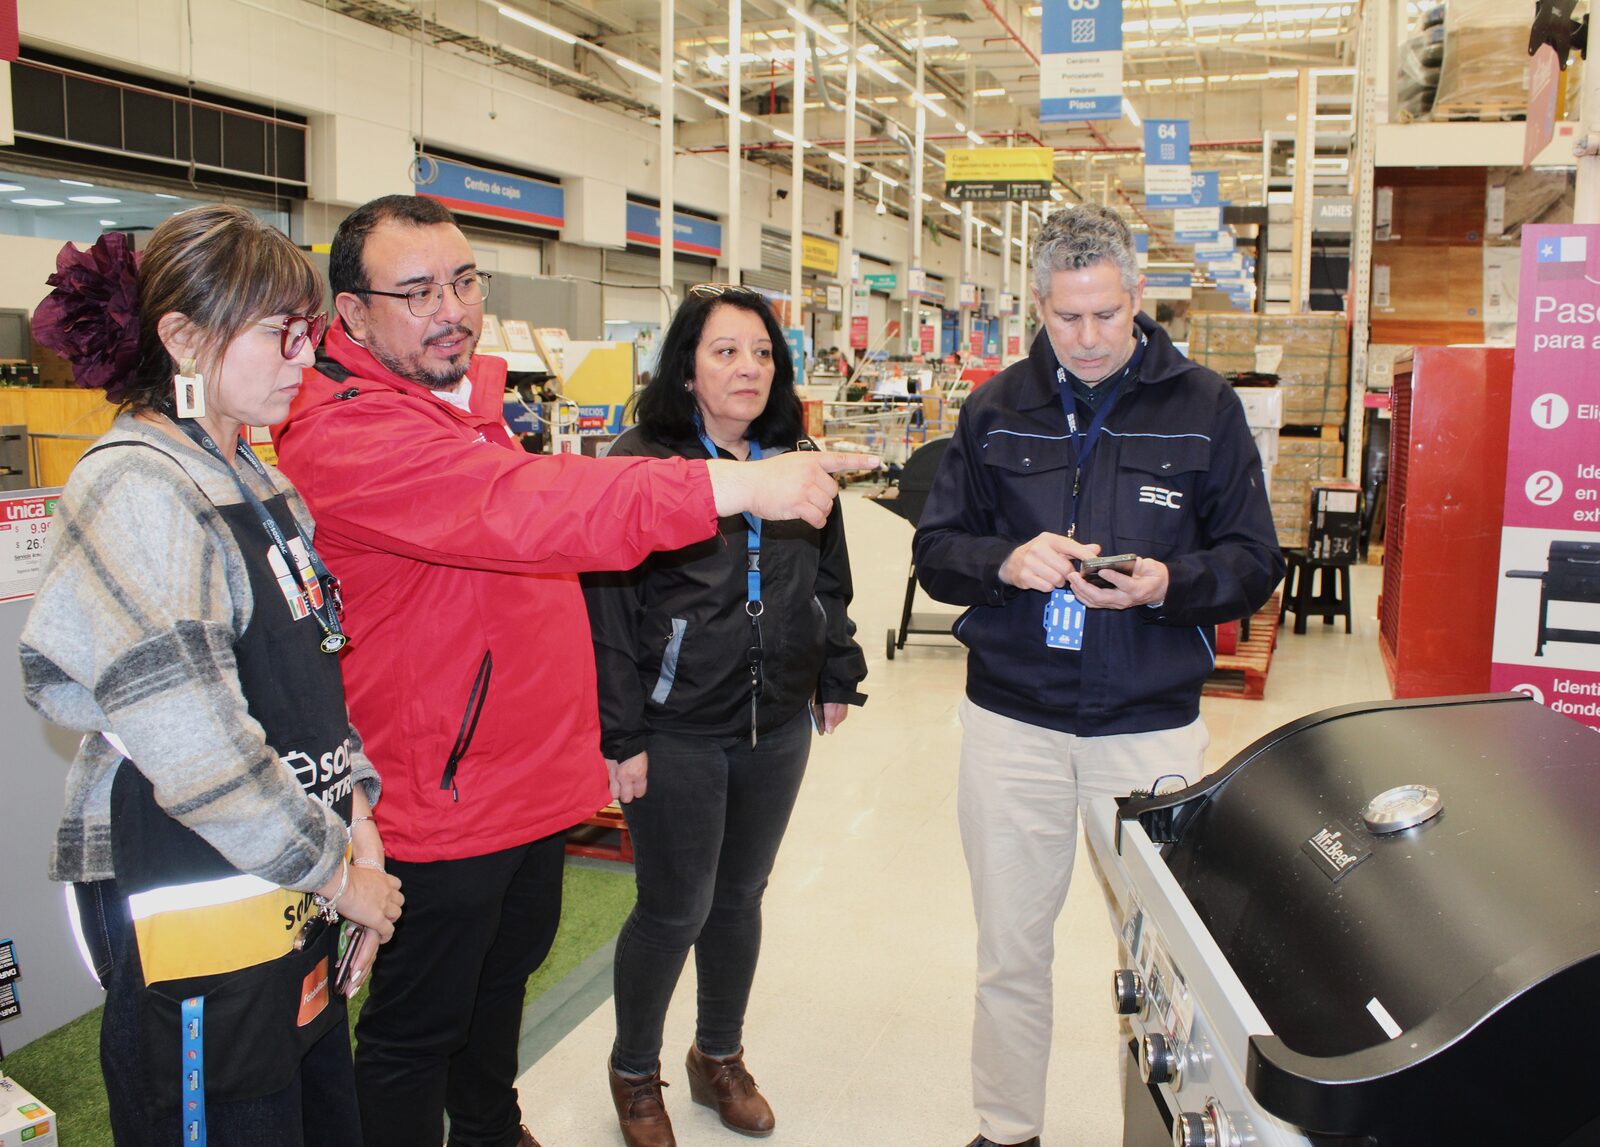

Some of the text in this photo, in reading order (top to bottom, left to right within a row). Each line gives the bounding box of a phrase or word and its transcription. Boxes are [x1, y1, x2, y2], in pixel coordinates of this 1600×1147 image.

[1069, 100, 1097, 110] Pisos
[1158, 124, 1177, 139] 64
[464, 176, 521, 199] Centro de cajas
[1534, 296, 1600, 324] Pas
[1534, 334, 1585, 352] para
[1540, 398, 1600, 424] 1 Eli
[1139, 485, 1183, 509] SEC
[1534, 475, 1553, 501] 2
[1575, 488, 1597, 500] en
[31, 522, 52, 534] 9.9
[27, 537, 46, 550] 26.
[270, 526, 288, 555] SODIMAC
